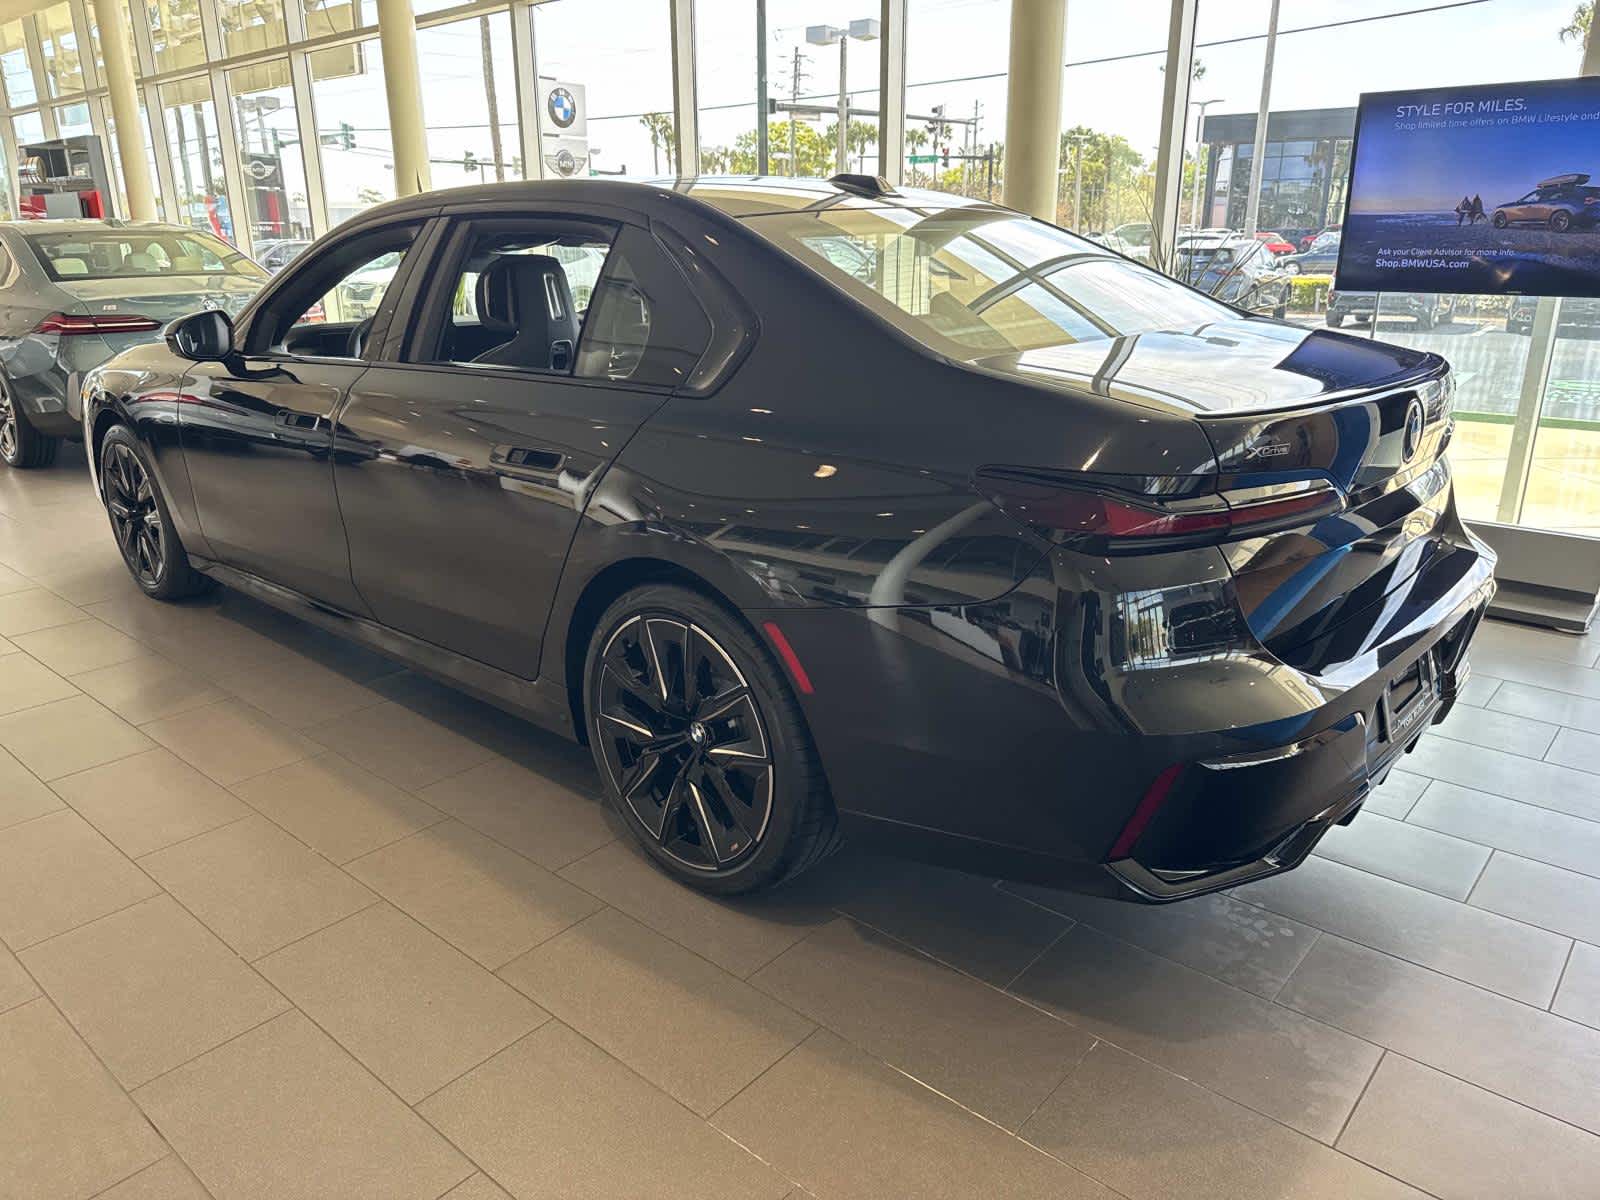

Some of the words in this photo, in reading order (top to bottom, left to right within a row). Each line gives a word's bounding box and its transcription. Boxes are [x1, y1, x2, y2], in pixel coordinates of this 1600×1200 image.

[1396, 103, 1441, 118] STYLE
[1444, 102, 1475, 115] FOR
[1478, 98, 1528, 113] MILES.
[1394, 121, 1417, 131] Shop
[1418, 120, 1447, 129] limited
[1448, 118, 1469, 129] time
[1497, 118, 1509, 126] on
[1511, 114, 1537, 125] BMW
[1538, 112, 1579, 124] Lifestyle
[1580, 111, 1600, 121] and
[1377, 247, 1391, 256] Ask
[1392, 248, 1410, 258] your
[1410, 247, 1433, 257] Client
[1433, 247, 1462, 256] Advisor
[1463, 248, 1476, 257] for
[1476, 248, 1498, 256] more
[1375, 258, 1470, 270] Shop.BMWUSA.com
